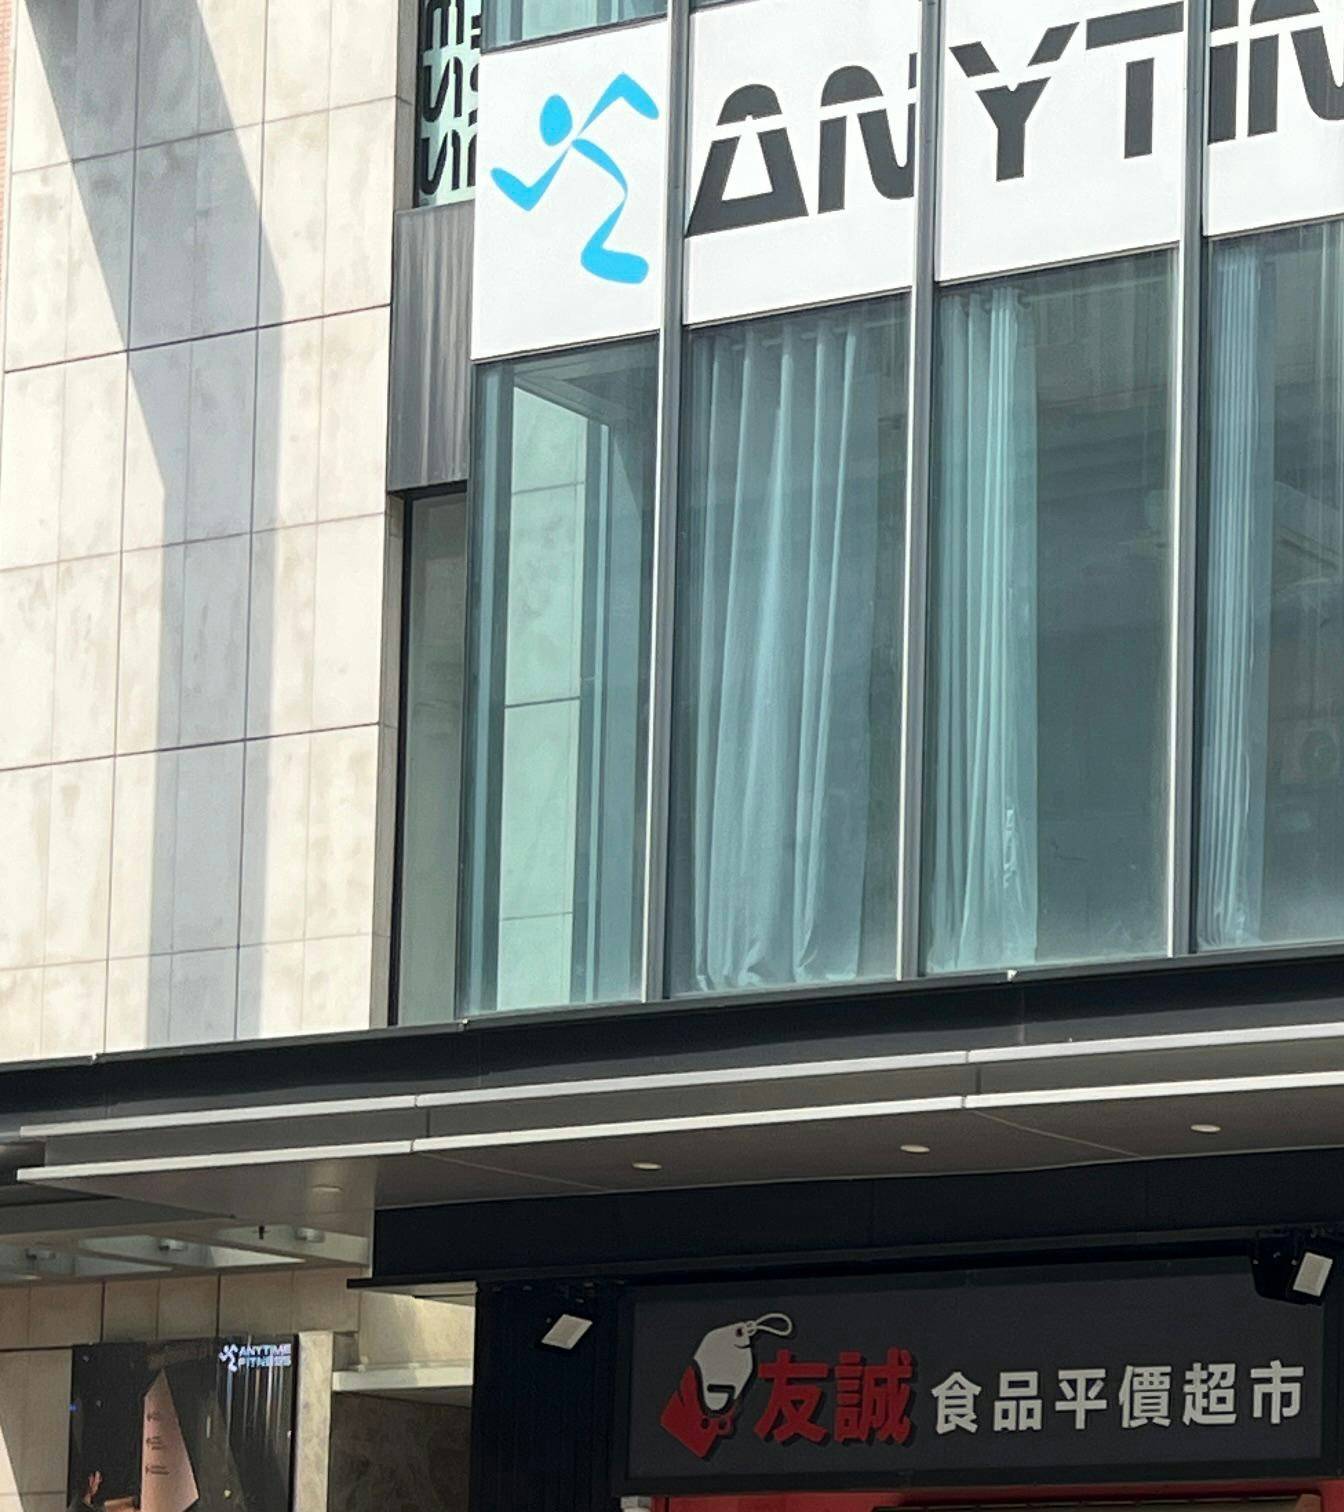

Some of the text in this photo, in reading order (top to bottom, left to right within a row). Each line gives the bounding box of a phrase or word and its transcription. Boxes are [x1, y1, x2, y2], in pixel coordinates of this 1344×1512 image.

[239, 1344, 292, 1356] ANYTIME
[753, 1348, 1307, 1446] 友誠 食品平價超市
